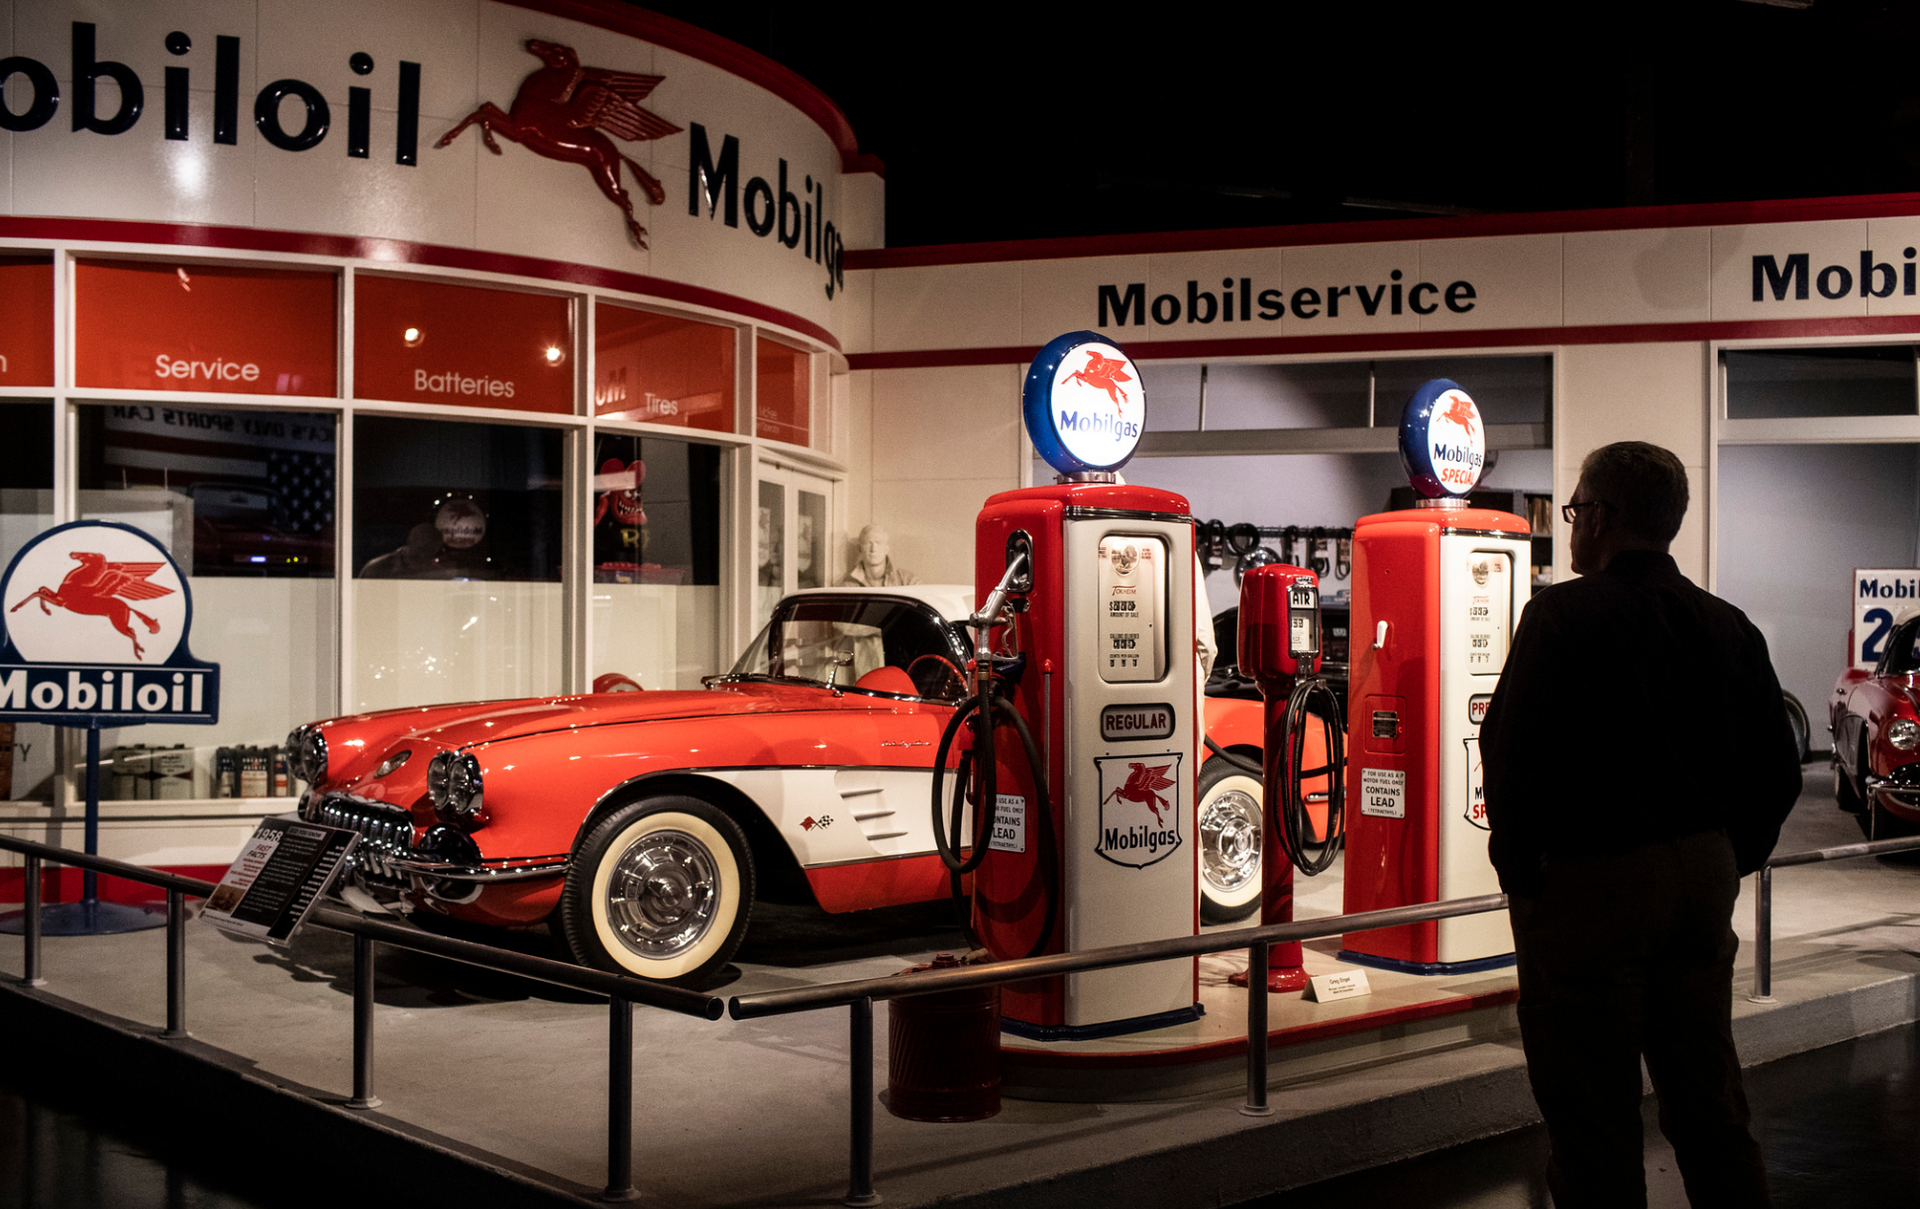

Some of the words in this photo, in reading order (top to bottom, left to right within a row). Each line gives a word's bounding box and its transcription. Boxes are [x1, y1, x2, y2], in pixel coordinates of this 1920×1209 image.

[1097, 269, 1478, 328] Mobilservice
[155, 354, 260, 383] Service
[414, 368, 515, 399] Batteries
[645, 392, 678, 416] Tires
[1060, 410, 1138, 442] Mobilgas
[1433, 443, 1482, 470] Mobilgas
[1441, 468, 1475, 486] SPECIAL
[1293, 592, 1310, 605] AIR
[0, 670, 204, 712] Mobiloil
[1106, 713, 1166, 731] REGULAR
[1365, 785, 1401, 797] CONTAINS
[1370, 796, 1395, 807] LEAD
[257, 828, 284, 843] 1958
[1104, 825, 1175, 853] Mobilgas
[247, 850, 268, 860] FACTS
[255, 843, 273, 852] FAST
